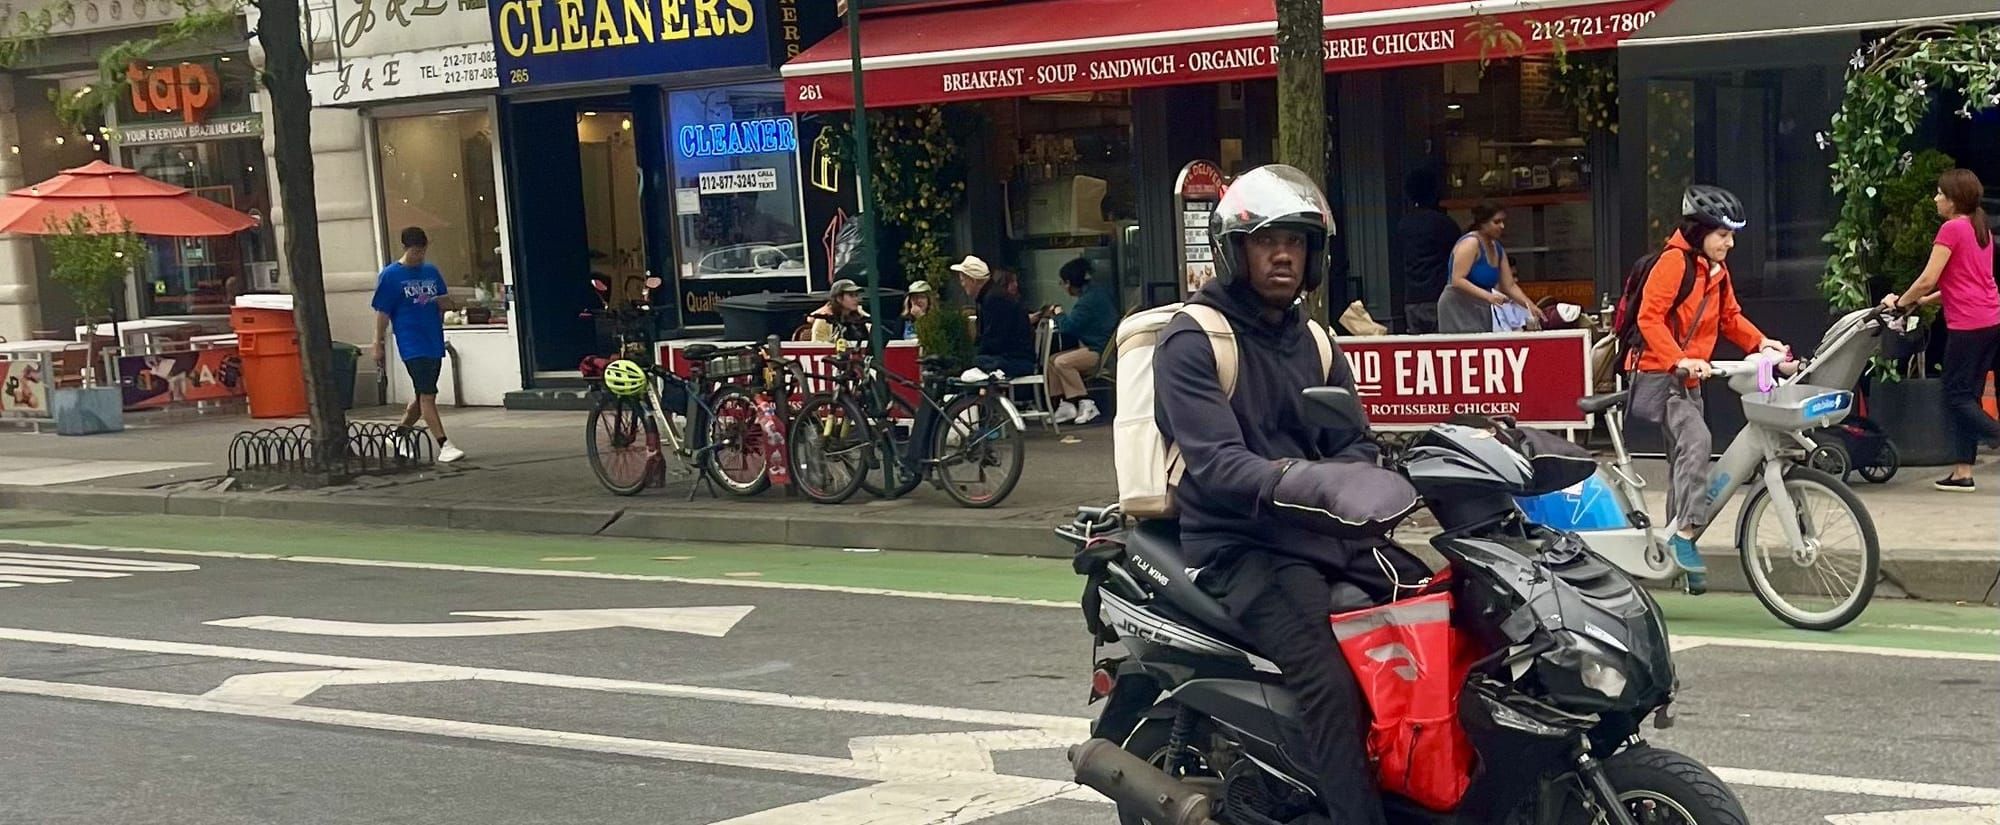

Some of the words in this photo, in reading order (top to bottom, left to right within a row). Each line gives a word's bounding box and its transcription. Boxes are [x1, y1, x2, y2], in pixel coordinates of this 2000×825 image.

[499, 0, 755, 57] CLEANERS
[780, 0, 801, 58] ERS
[443, 51, 496, 68] 212-787-082
[943, 67, 1025, 92] BREAKFAST
[1037, 63, 1078, 85] SOUP
[1089, 54, 1176, 81] SANDWICH
[1188, 45, 1266, 72] ORGANIC
[1372, 28, 1456, 55] CHICKEN
[383, 60, 401, 86] E
[510, 69, 529, 84] 265
[126, 63, 209, 124] tap
[799, 84, 823, 101] 261
[126, 130, 147, 142] YOUR
[148, 126, 188, 141] EVERYDAY
[189, 122, 230, 138] BRAZILIAN
[701, 173, 757, 190] 212-877-3243
[758, 181, 775, 189] TEXT
[1344, 351, 1382, 384] ND
[1394, 346, 1530, 396] EATERY
[1371, 402, 1450, 416] ROTISSERIE
[1454, 401, 1520, 415] CHICKEN
[1132, 555, 1151, 572] FLY
